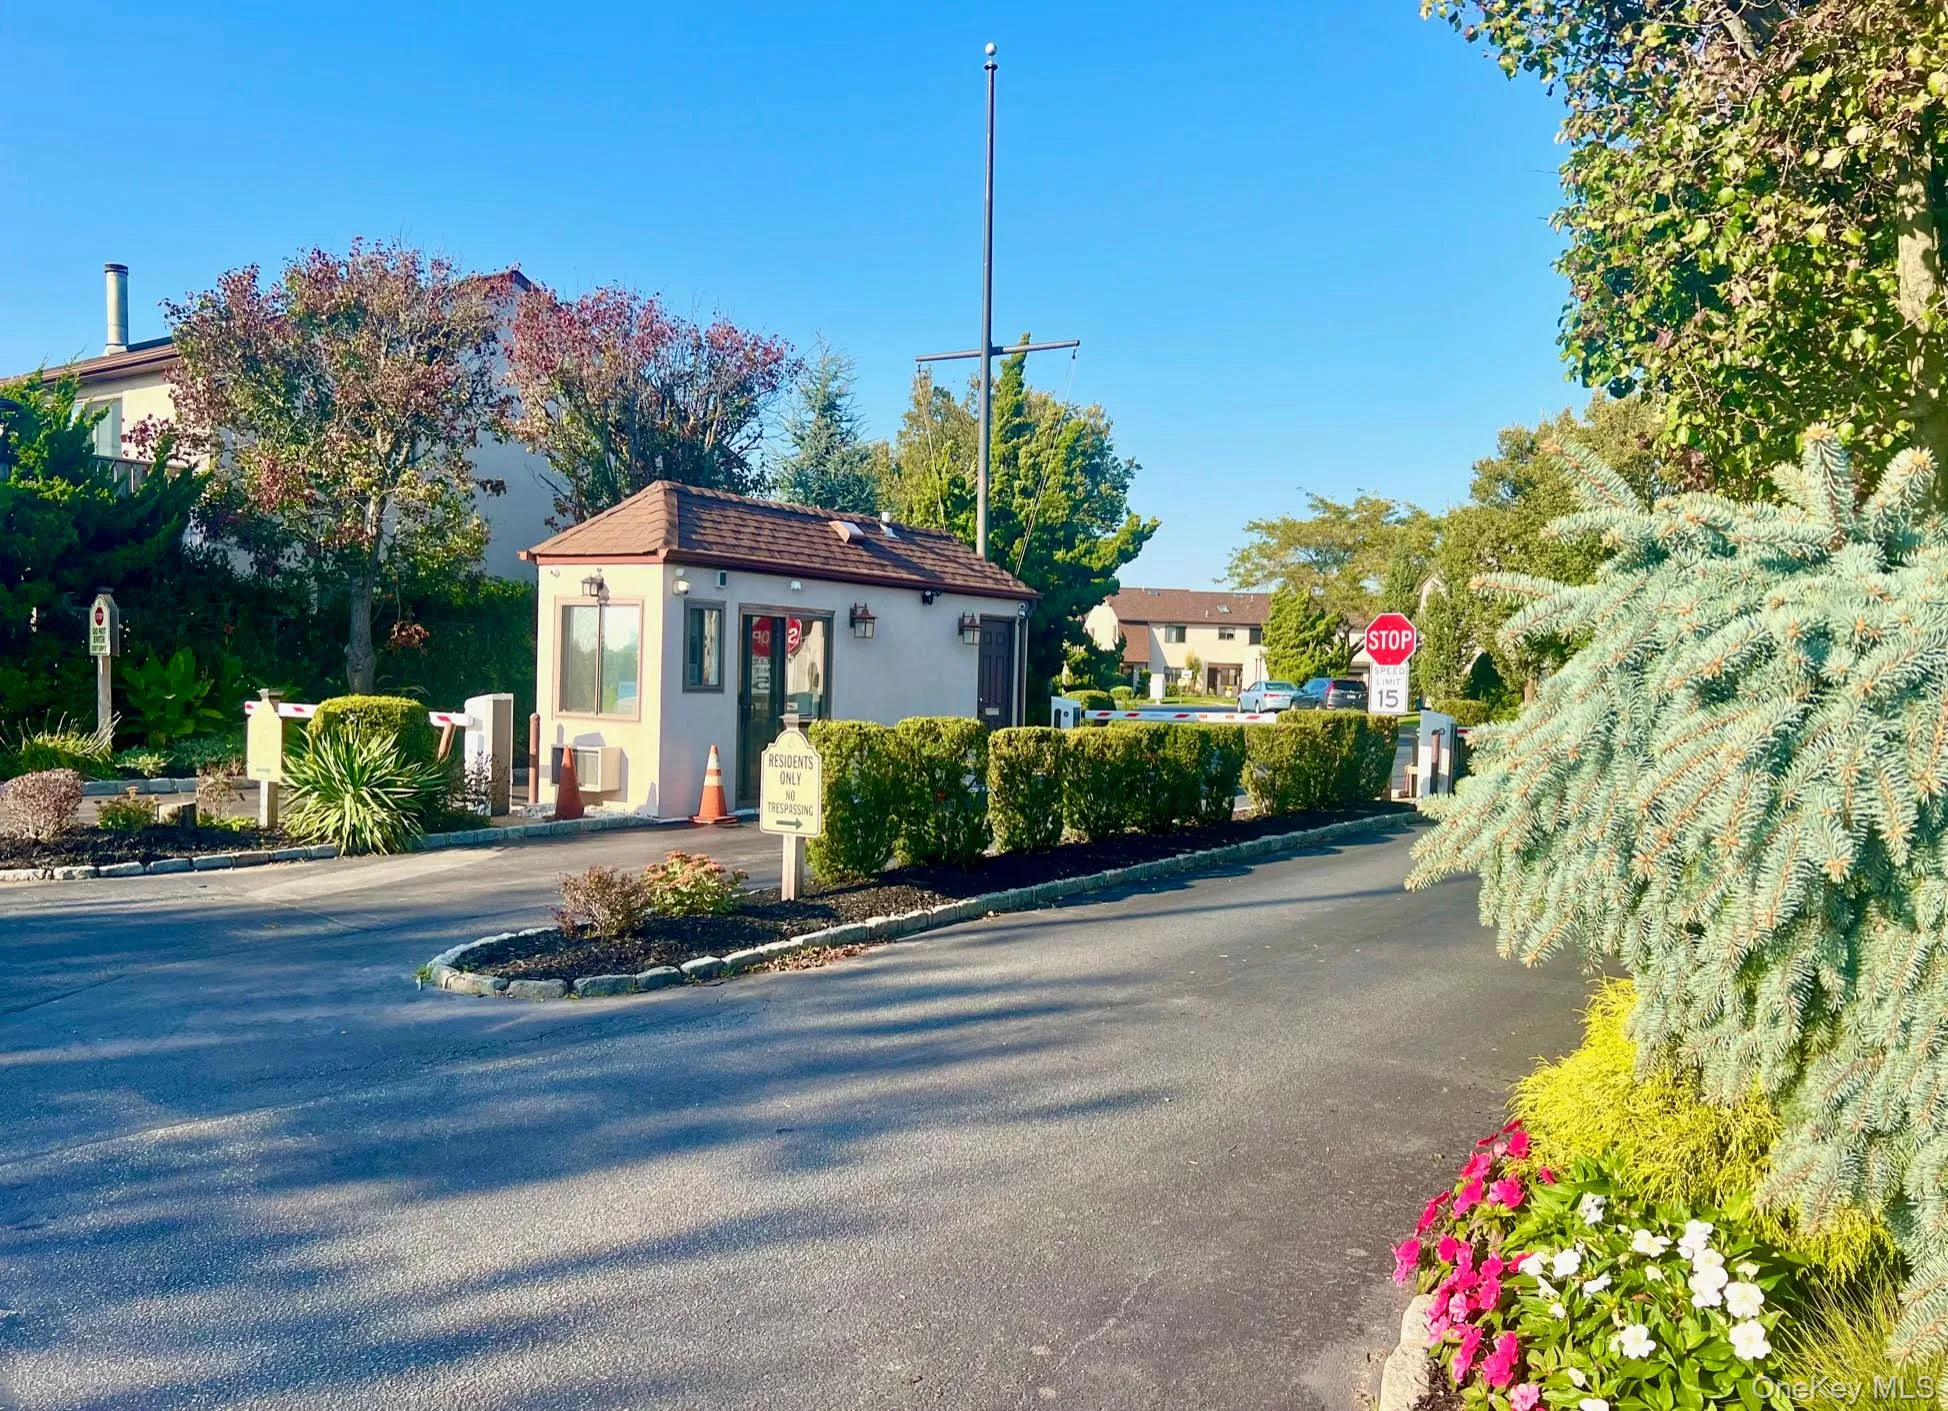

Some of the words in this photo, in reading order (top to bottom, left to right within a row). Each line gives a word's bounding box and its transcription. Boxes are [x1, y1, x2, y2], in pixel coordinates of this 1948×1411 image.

[94, 635, 105, 643] ENTER
[1368, 630, 1412, 650] STOP
[1374, 666, 1405, 675] SPEED
[1376, 678, 1401, 686] LIMIT
[1378, 689, 1399, 708] 15
[768, 753, 814, 770] RESIDENTS
[779, 770, 802, 787] ONLY
[785, 790, 796, 802] NO
[767, 801, 814, 817] TRESPASSING
